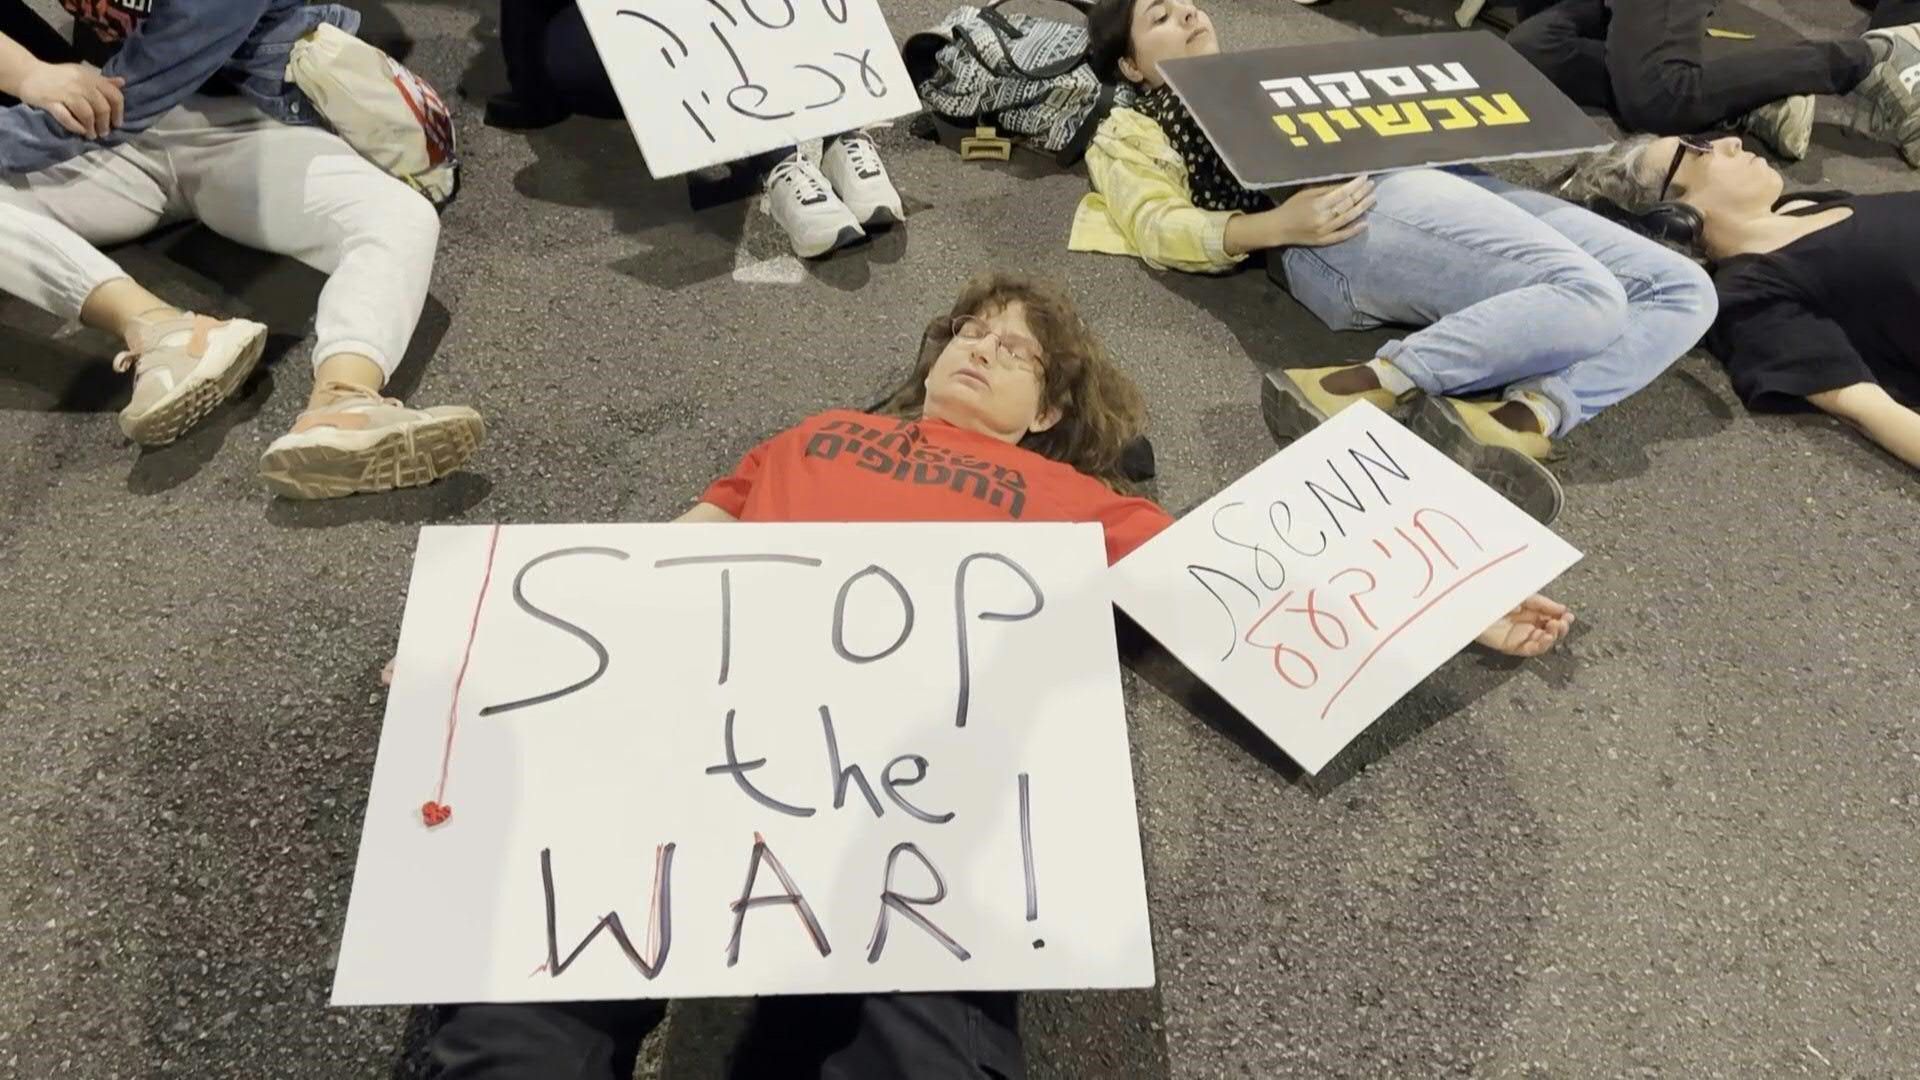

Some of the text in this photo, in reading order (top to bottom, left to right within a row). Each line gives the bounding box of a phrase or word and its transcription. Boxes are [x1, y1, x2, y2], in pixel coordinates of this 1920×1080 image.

[682, 48, 887, 142] עכשיו
[1259, 61, 1480, 108] עסקה
[1271, 92, 1531, 147] עכשיו!
[805, 432, 1027, 519] החטופים
[1187, 430, 1410, 661] ממשלת
[480, 545, 1044, 727] STOP
[705, 704, 956, 824] the
[528, 773, 1048, 980] WAR!
